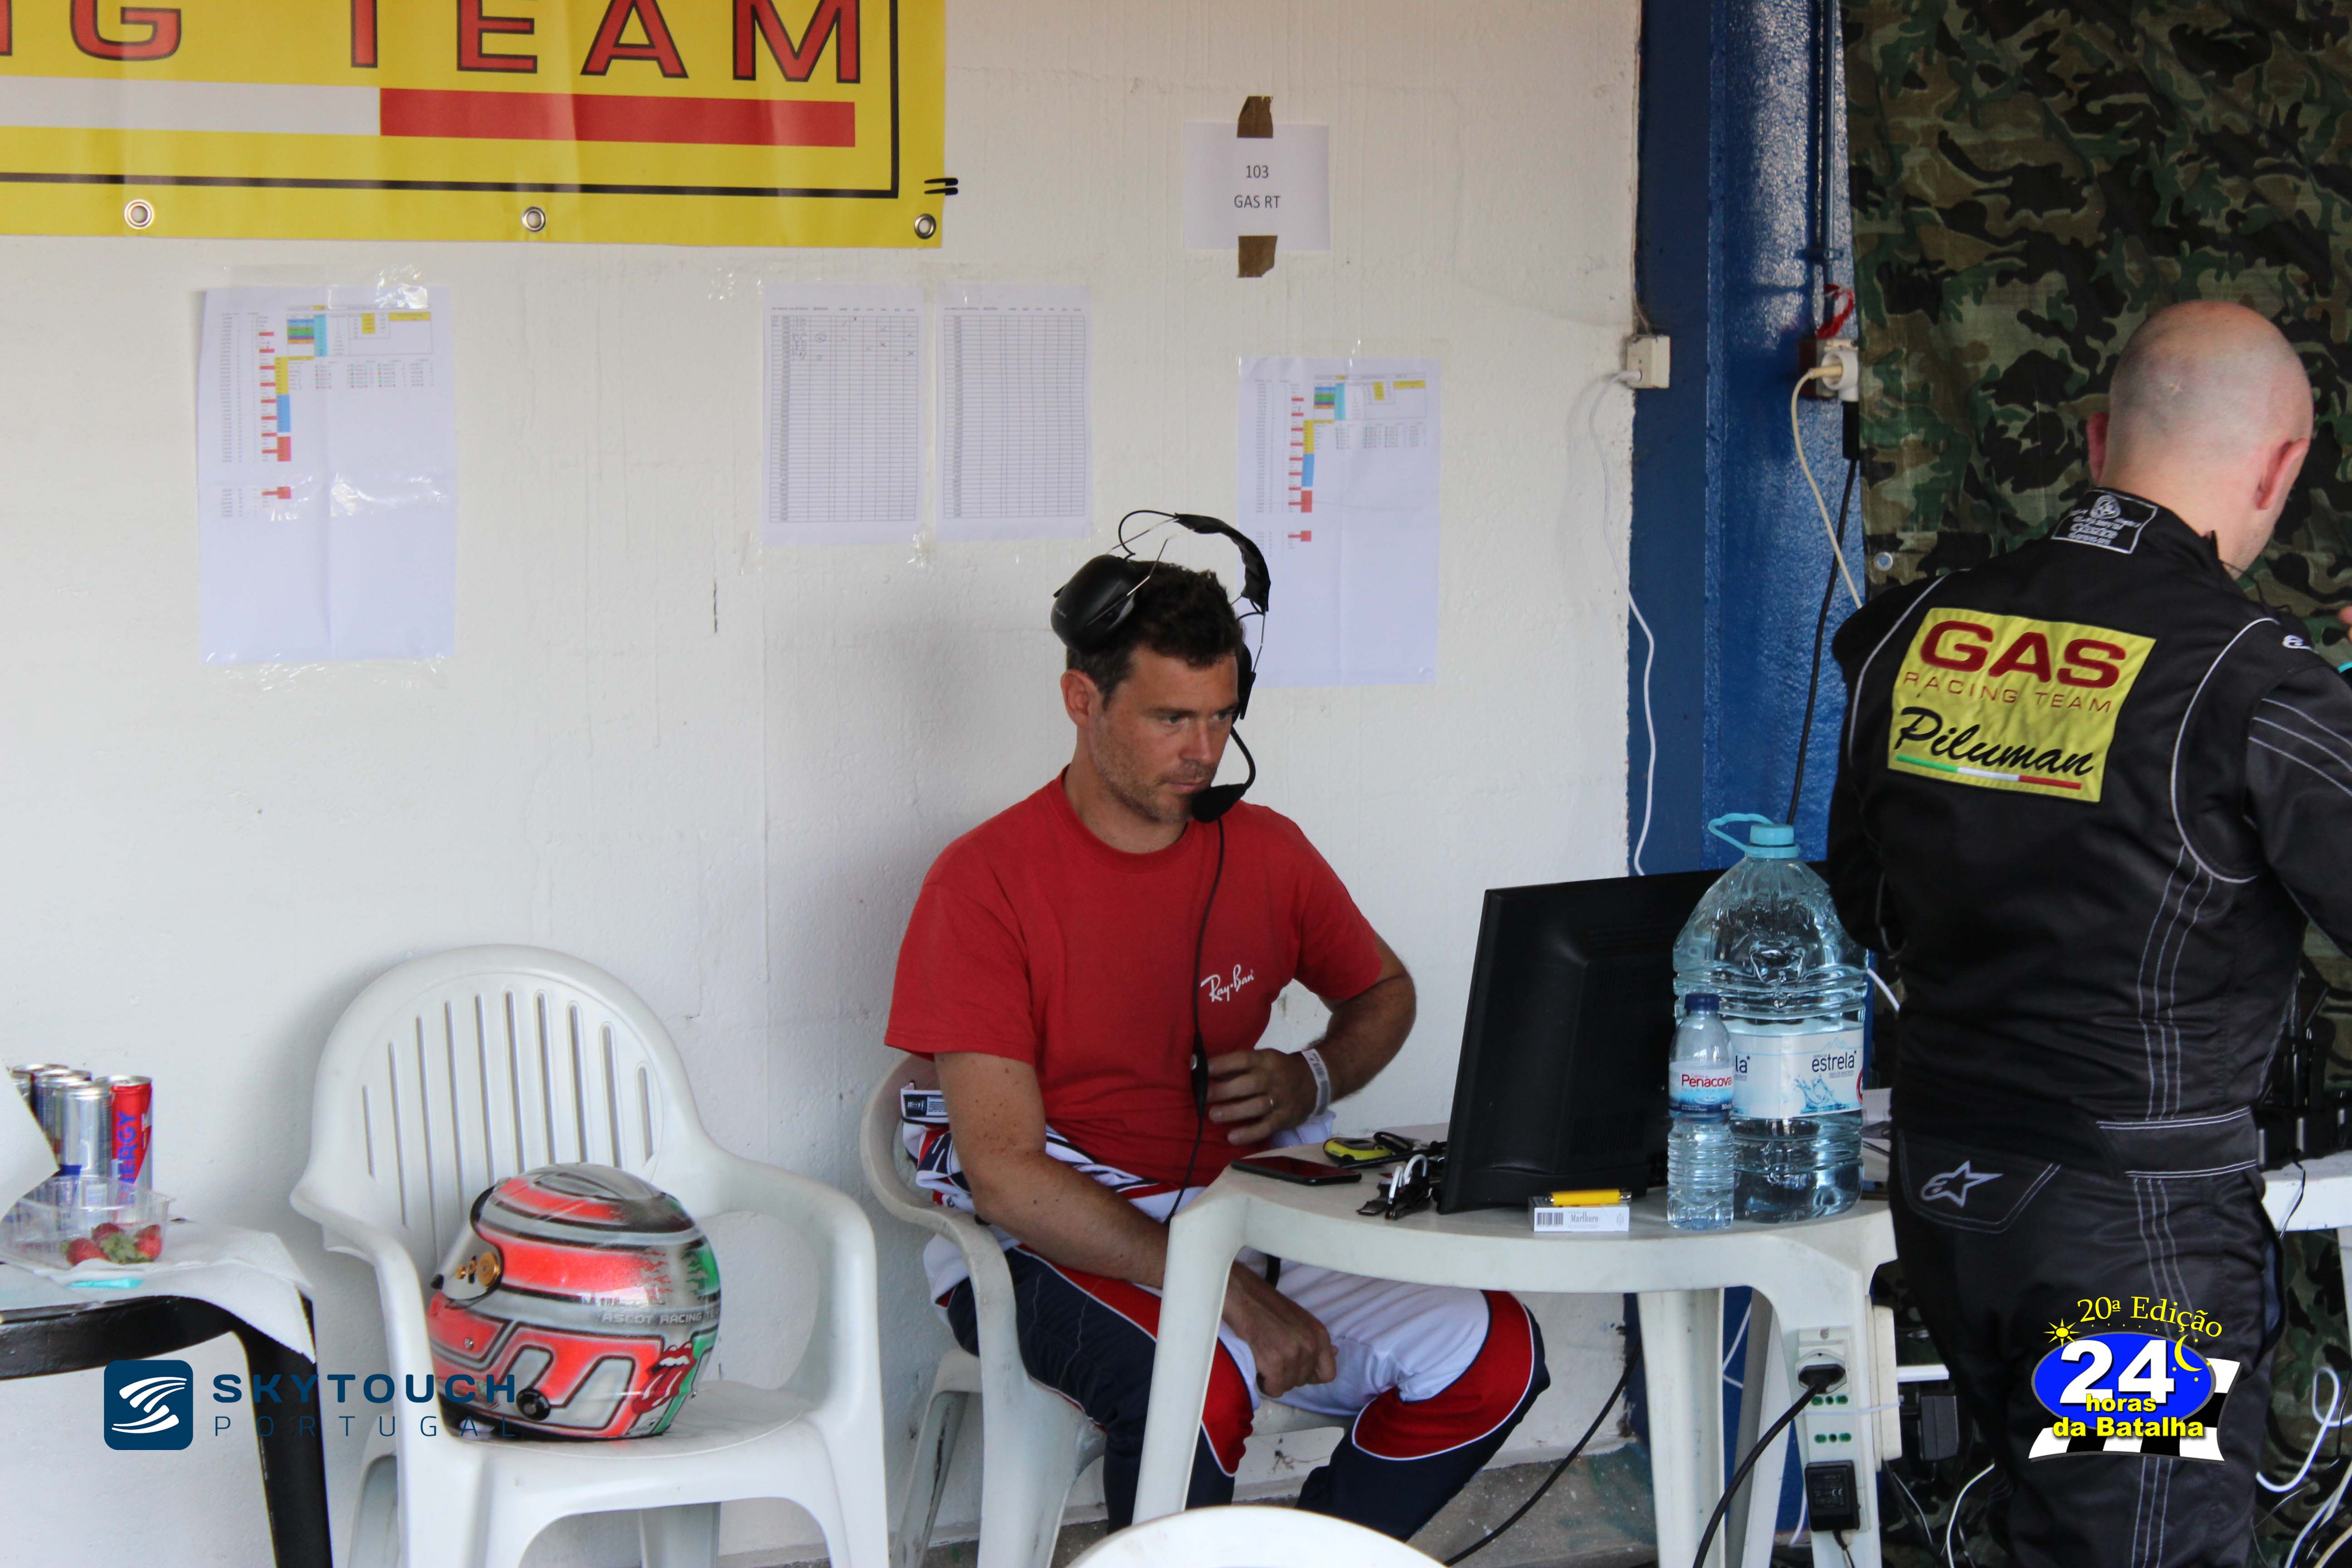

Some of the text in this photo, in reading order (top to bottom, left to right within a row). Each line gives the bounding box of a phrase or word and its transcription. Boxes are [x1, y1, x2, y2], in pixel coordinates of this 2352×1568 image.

[1246, 165, 1269, 178] 103
[1234, 195, 1280, 208] GAS RT
[1921, 620, 2126, 688] GAS
[1903, 671, 2112, 713] RACING TEAM
[1894, 706, 2093, 776] Piluman
[1200, 964, 1254, 1002] Ray-Ban
[1812, 1051, 1854, 1072] estrela
[1681, 1074, 1732, 1088] Penacova
[660, 1312, 702, 1324] RACING
